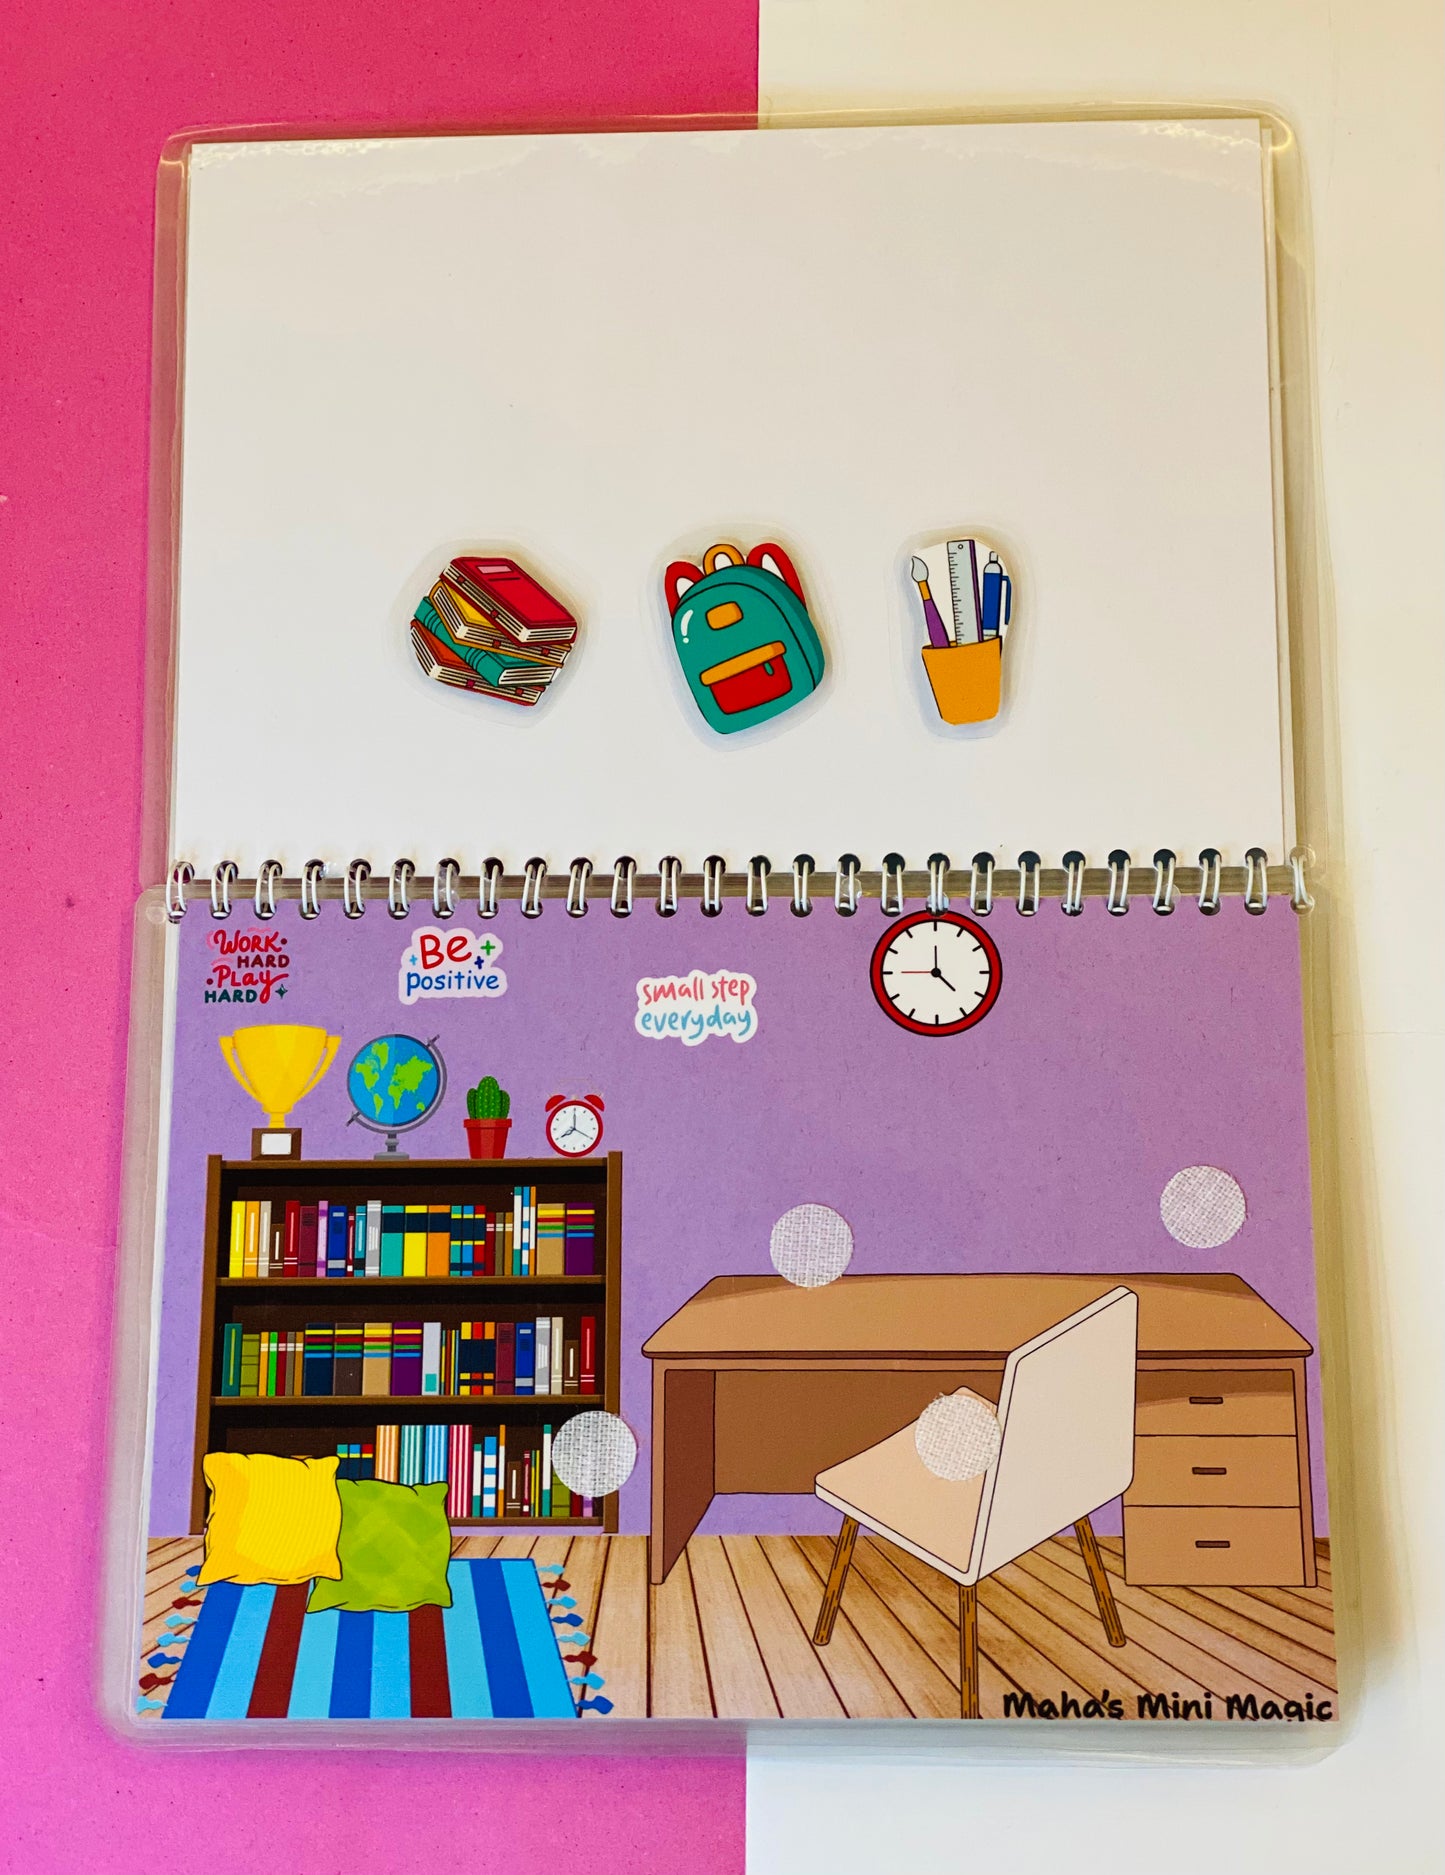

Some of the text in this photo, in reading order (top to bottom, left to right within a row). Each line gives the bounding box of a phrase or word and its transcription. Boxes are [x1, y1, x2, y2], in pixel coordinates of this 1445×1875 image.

[213, 929, 282, 955] WORK
[420, 934, 472, 970] Be
[237, 954, 290, 969] HARD
[204, 988, 258, 1004] HARD
[406, 971, 500, 997] positive
[642, 975, 750, 1006] small step
[641, 1004, 752, 1040] everyday
[1002, 1689, 1333, 1722] Maha's Mini Magic
